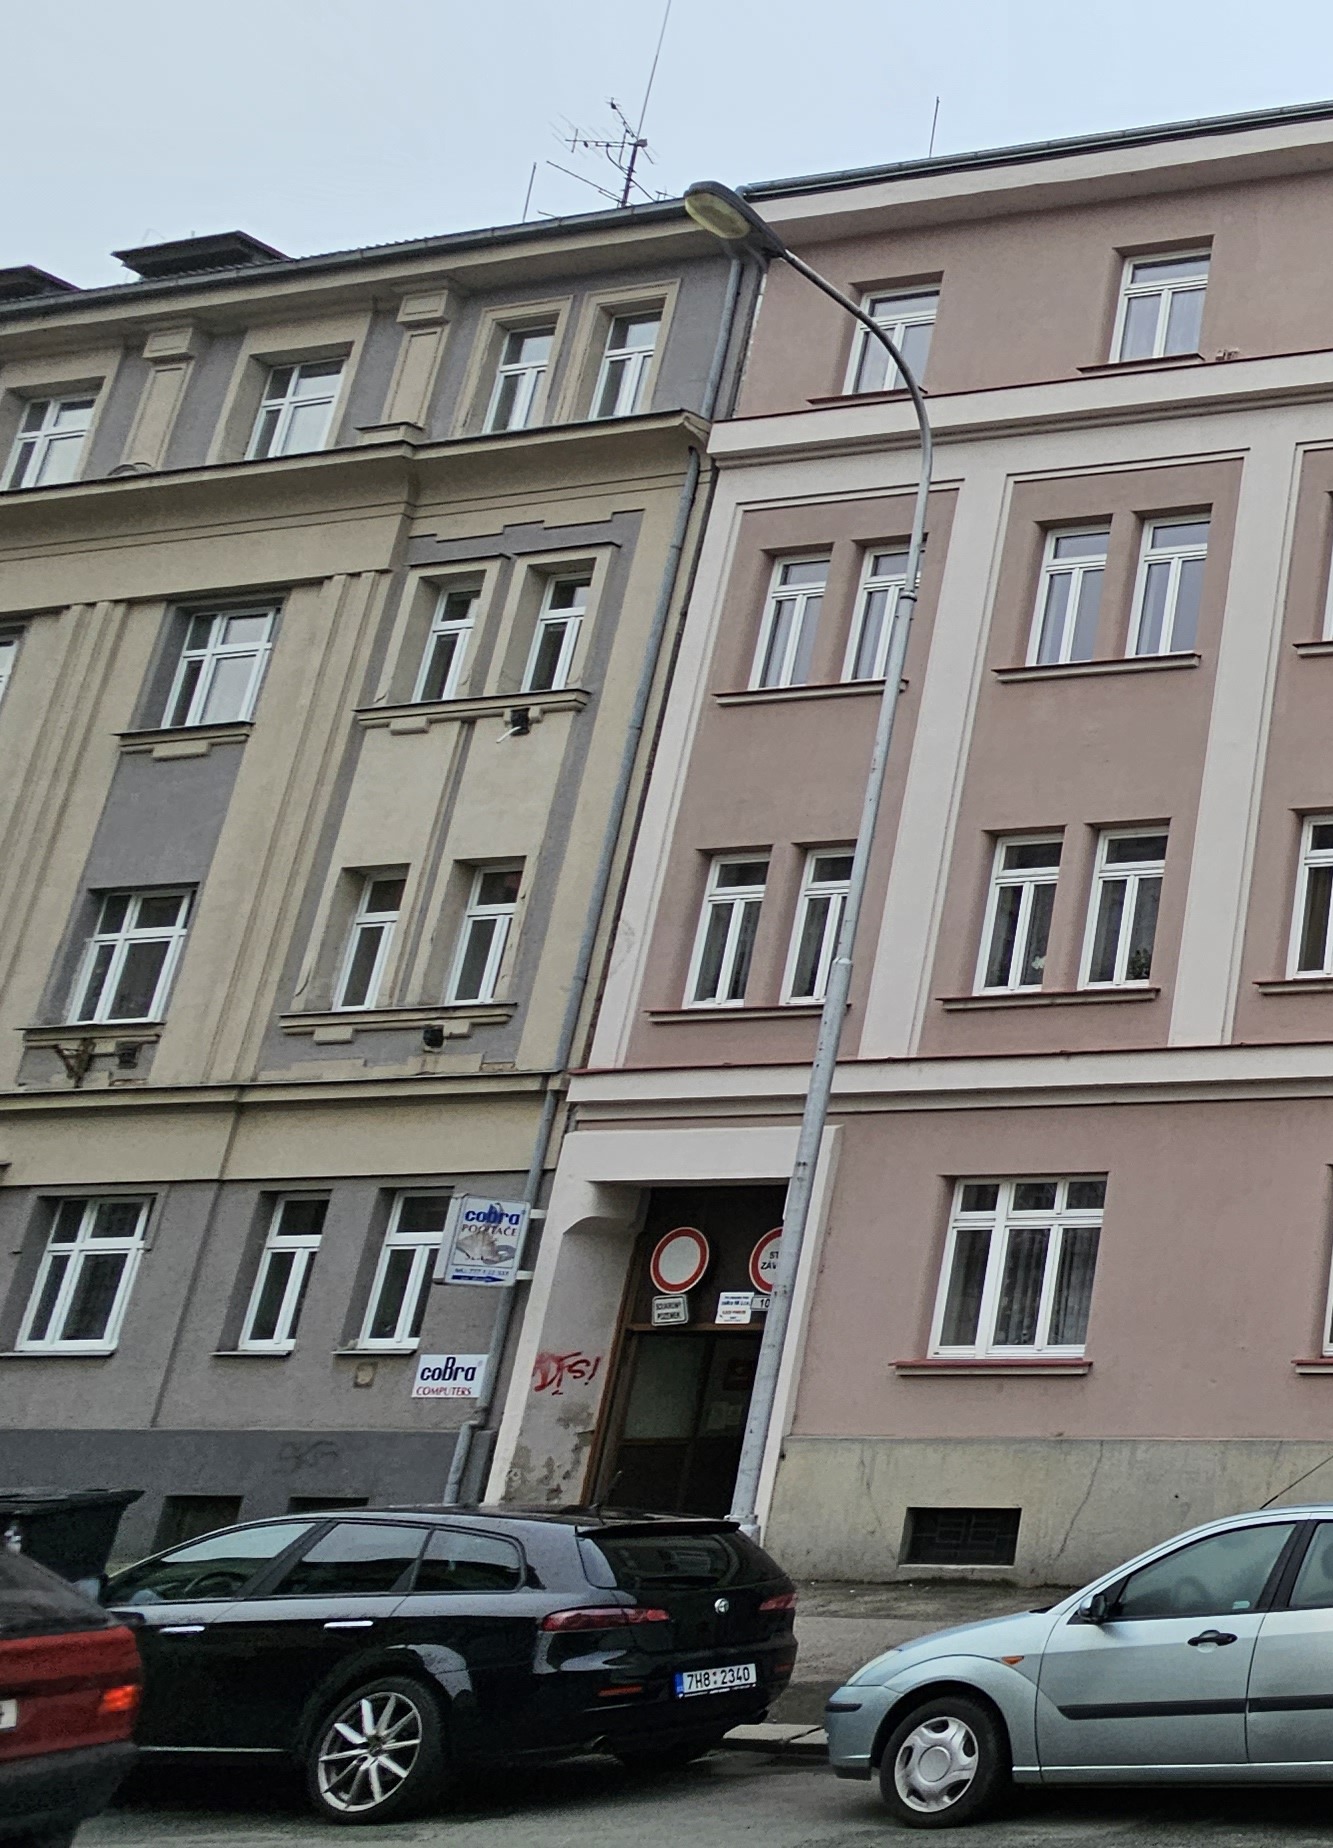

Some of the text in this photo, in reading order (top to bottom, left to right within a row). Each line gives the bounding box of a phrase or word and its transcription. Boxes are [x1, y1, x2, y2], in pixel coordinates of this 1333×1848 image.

[416, 1386, 472, 1396] COMPUTERS
[687, 1666, 751, 1690] 7H8 2340
